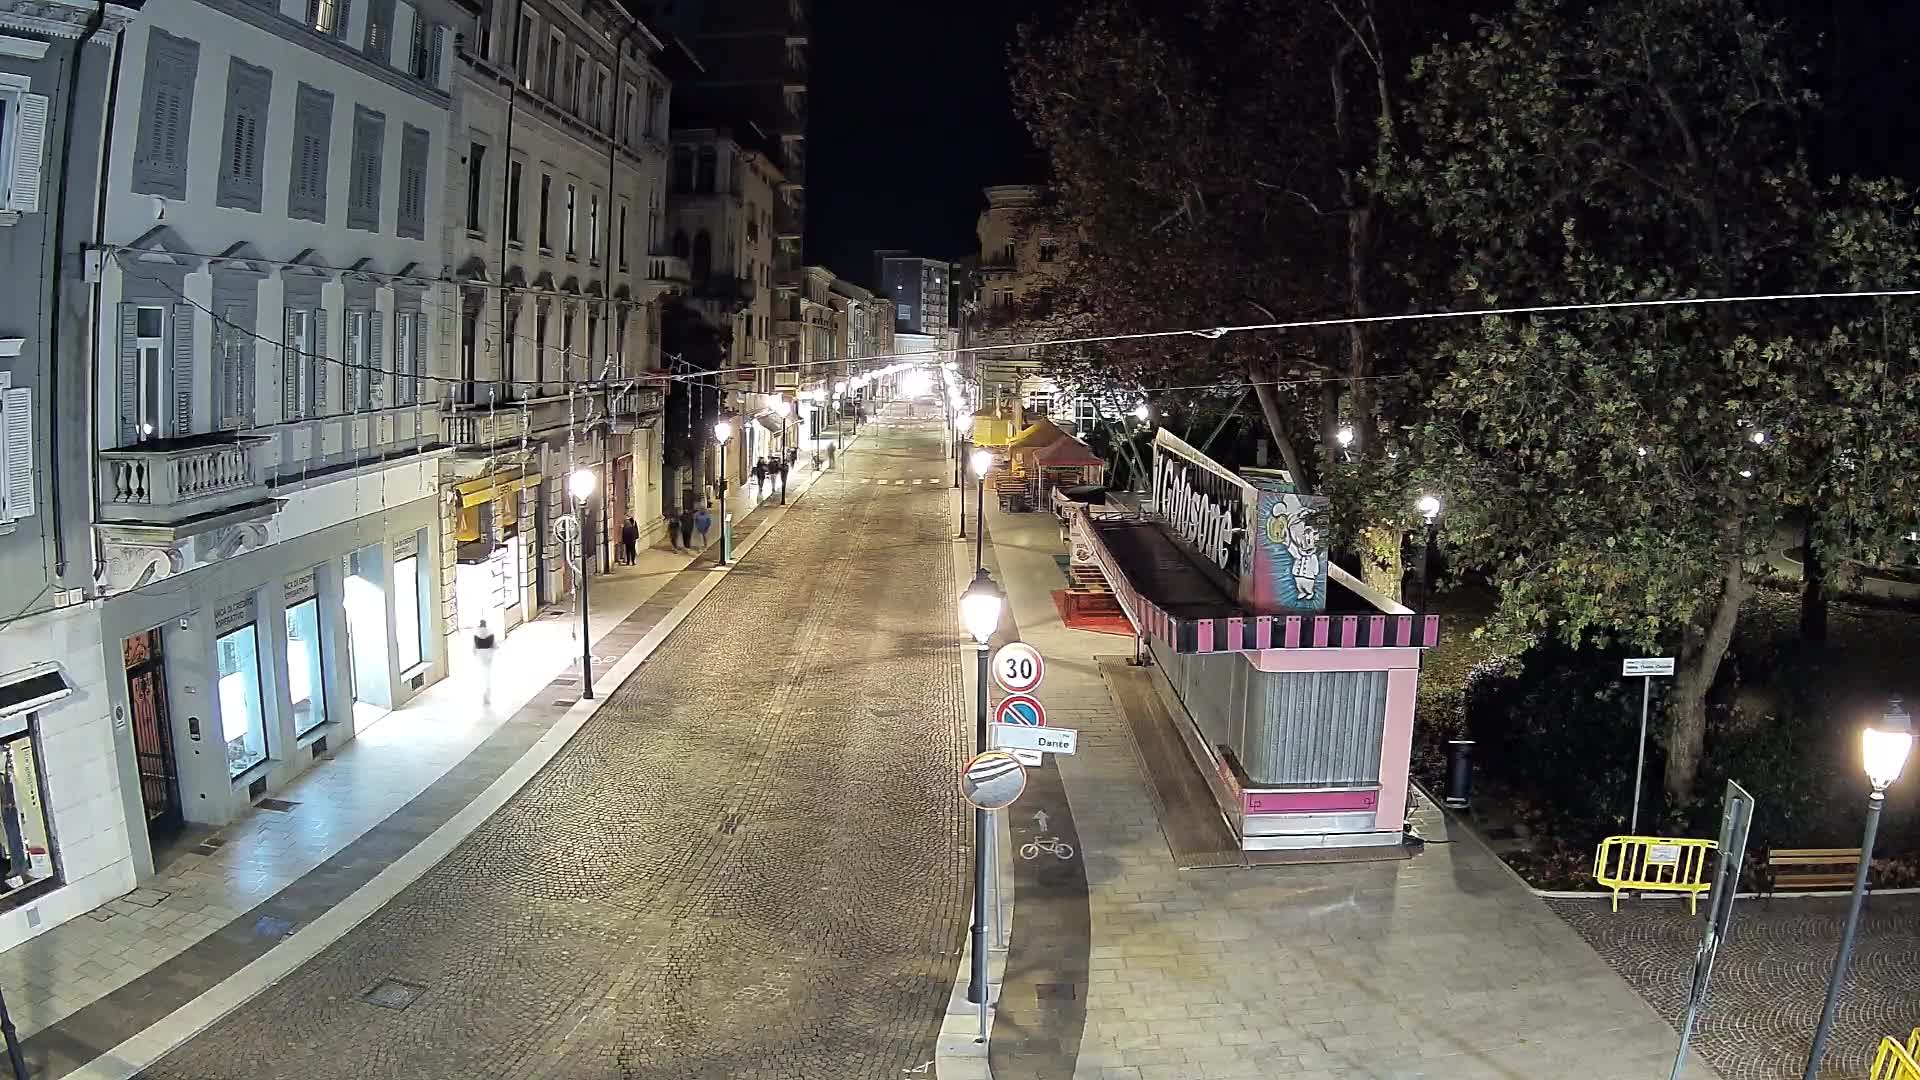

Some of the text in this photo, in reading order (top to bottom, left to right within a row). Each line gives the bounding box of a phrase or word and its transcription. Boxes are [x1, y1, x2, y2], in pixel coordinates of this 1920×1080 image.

[1162, 458, 1232, 570] Golosone
[1006, 658, 1032, 679] 30
[1038, 737, 1069, 748] Dante
